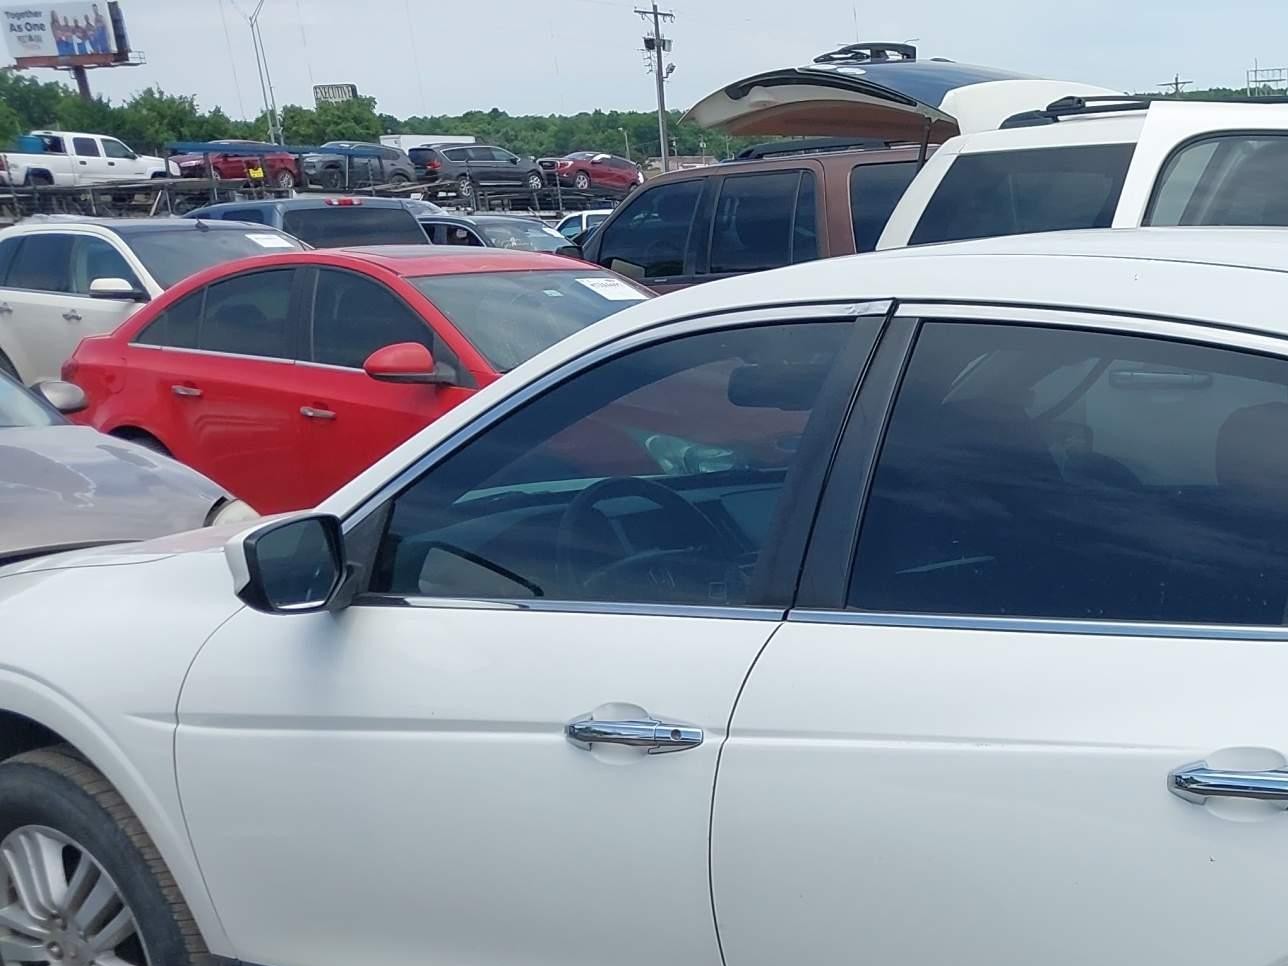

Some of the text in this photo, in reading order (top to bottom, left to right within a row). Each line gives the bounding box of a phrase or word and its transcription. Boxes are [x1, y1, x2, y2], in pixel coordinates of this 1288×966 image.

[4, 10, 42, 20] Together
[9, 22, 46, 32] As One
